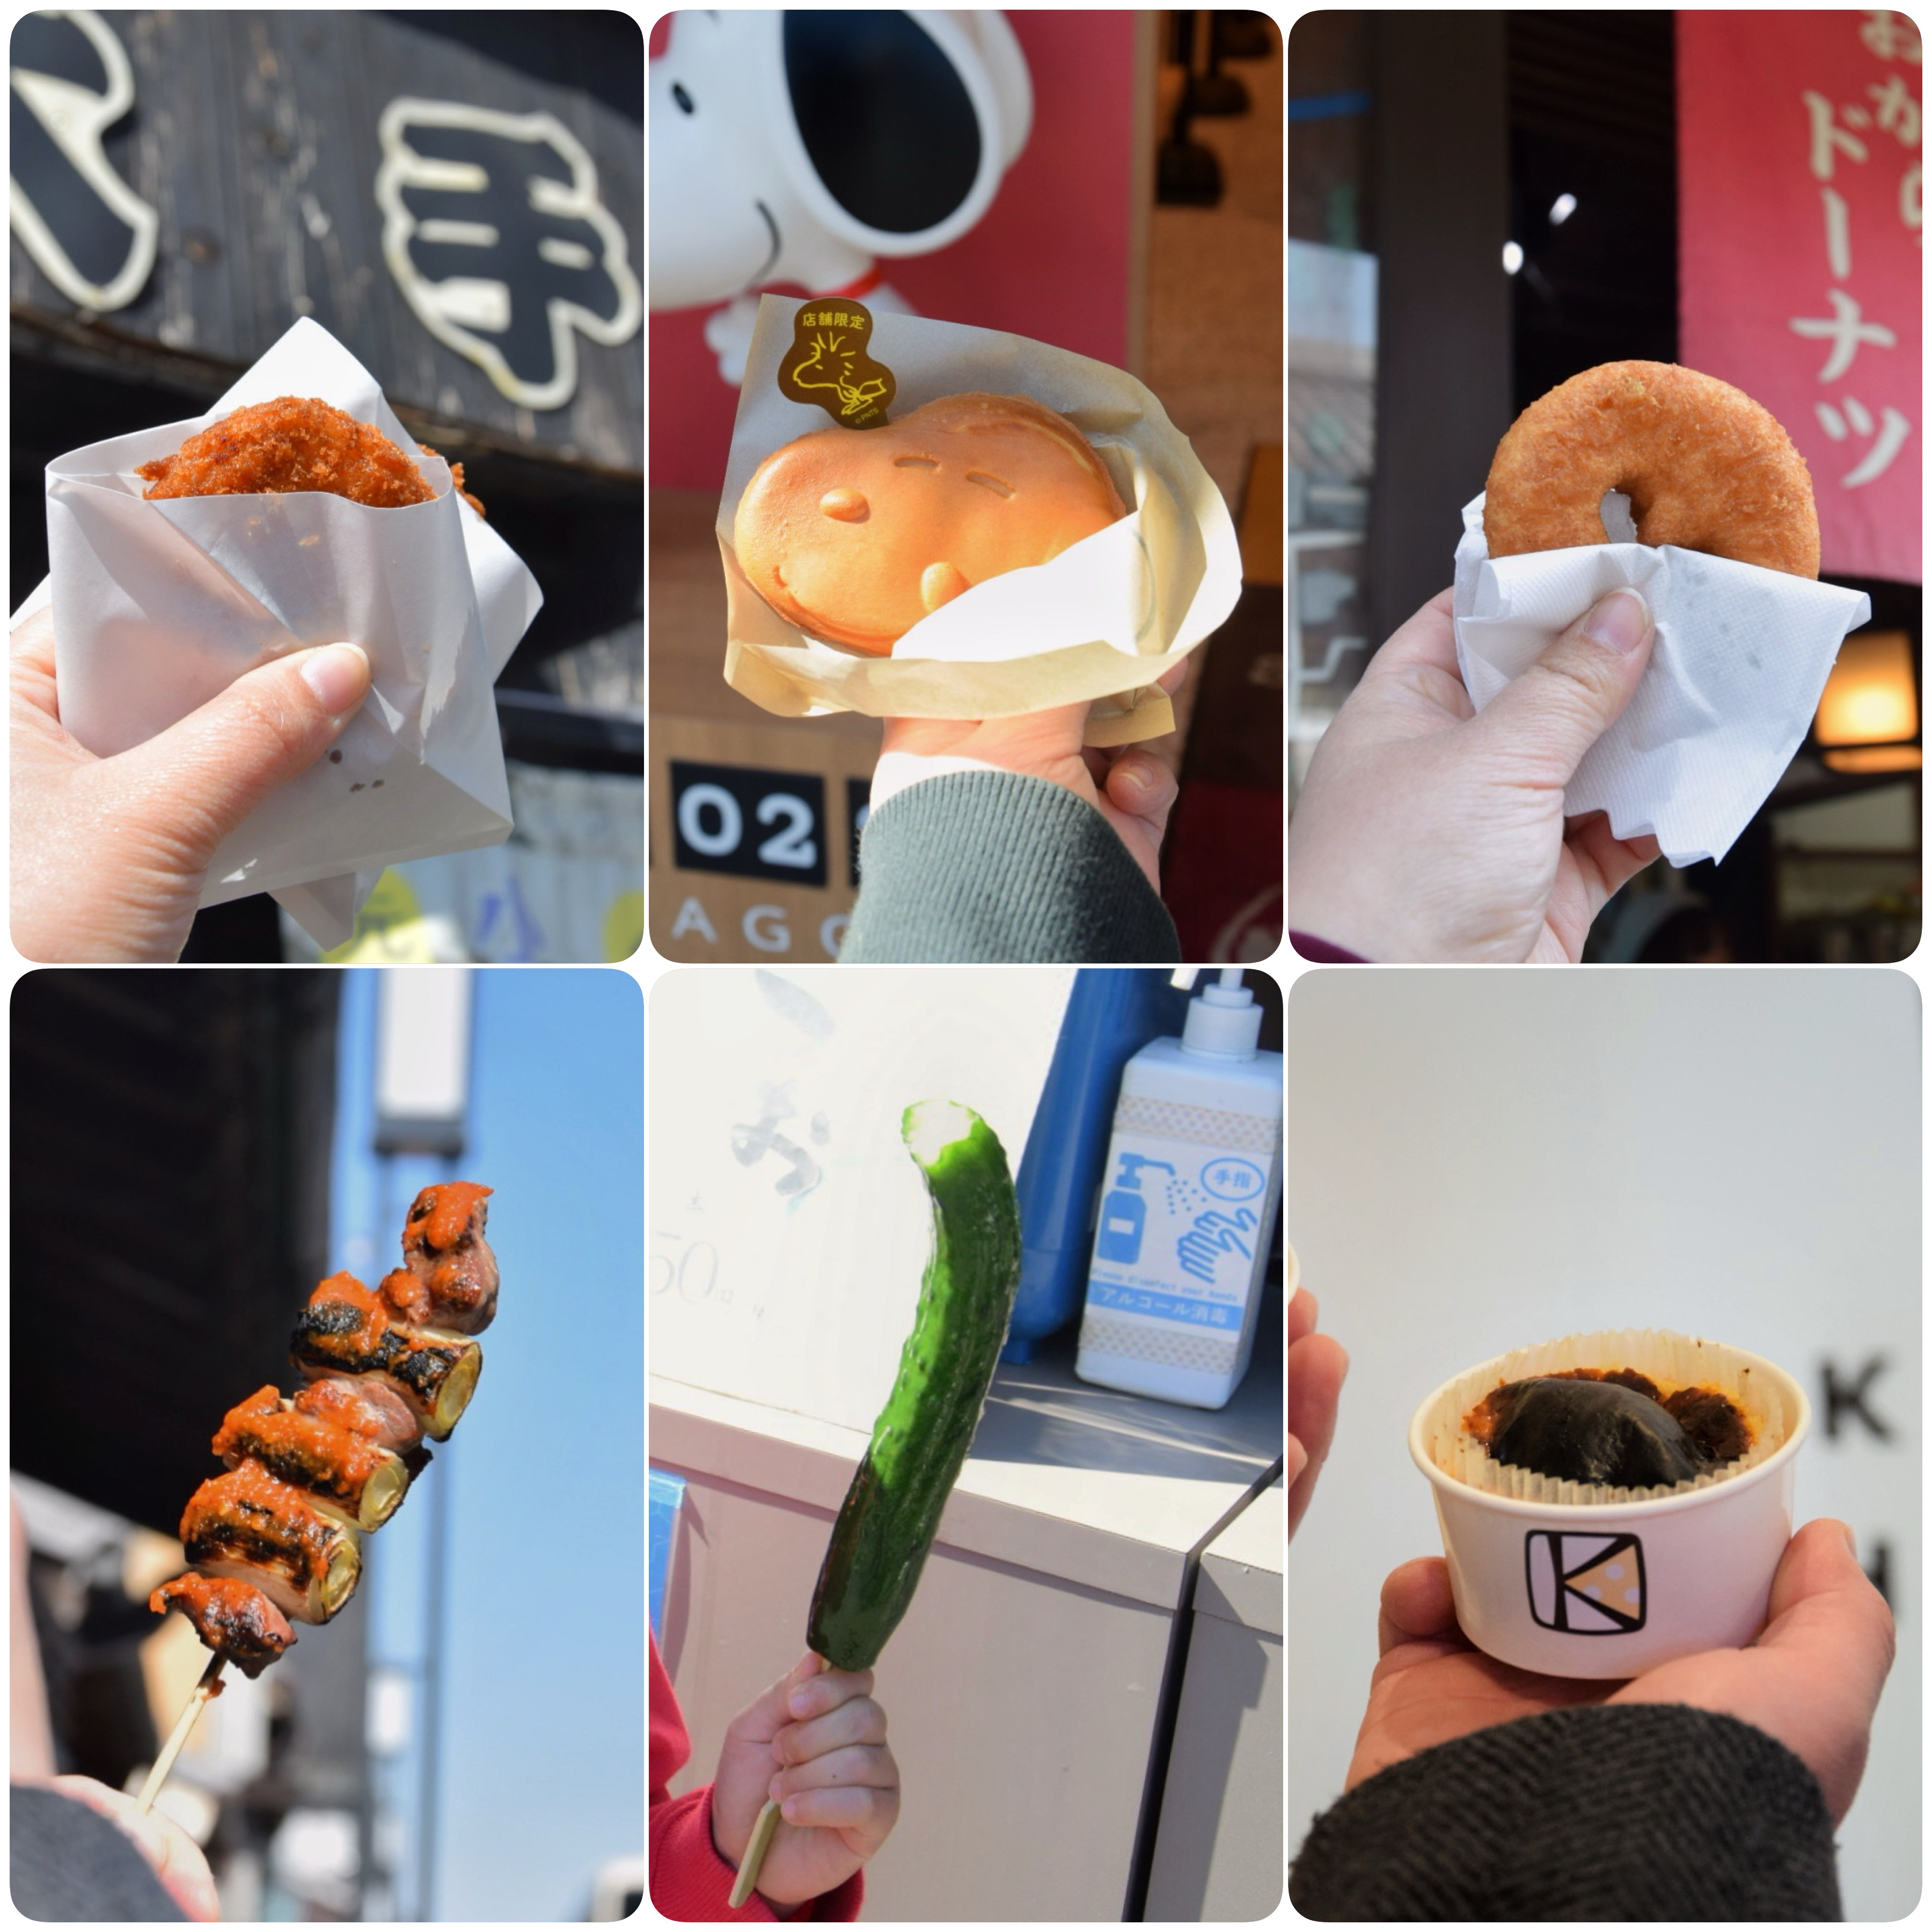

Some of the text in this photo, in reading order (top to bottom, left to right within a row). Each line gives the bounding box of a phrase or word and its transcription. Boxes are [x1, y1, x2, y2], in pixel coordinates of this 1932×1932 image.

[1789, 89, 1912, 488] ドーナツ
[803, 312, 865, 330] 店舗限定
[677, 782, 818, 869] 02
[1213, 1169, 1252, 1189] 手指
[1102, 1288, 1228, 1324] アルコール消毒
